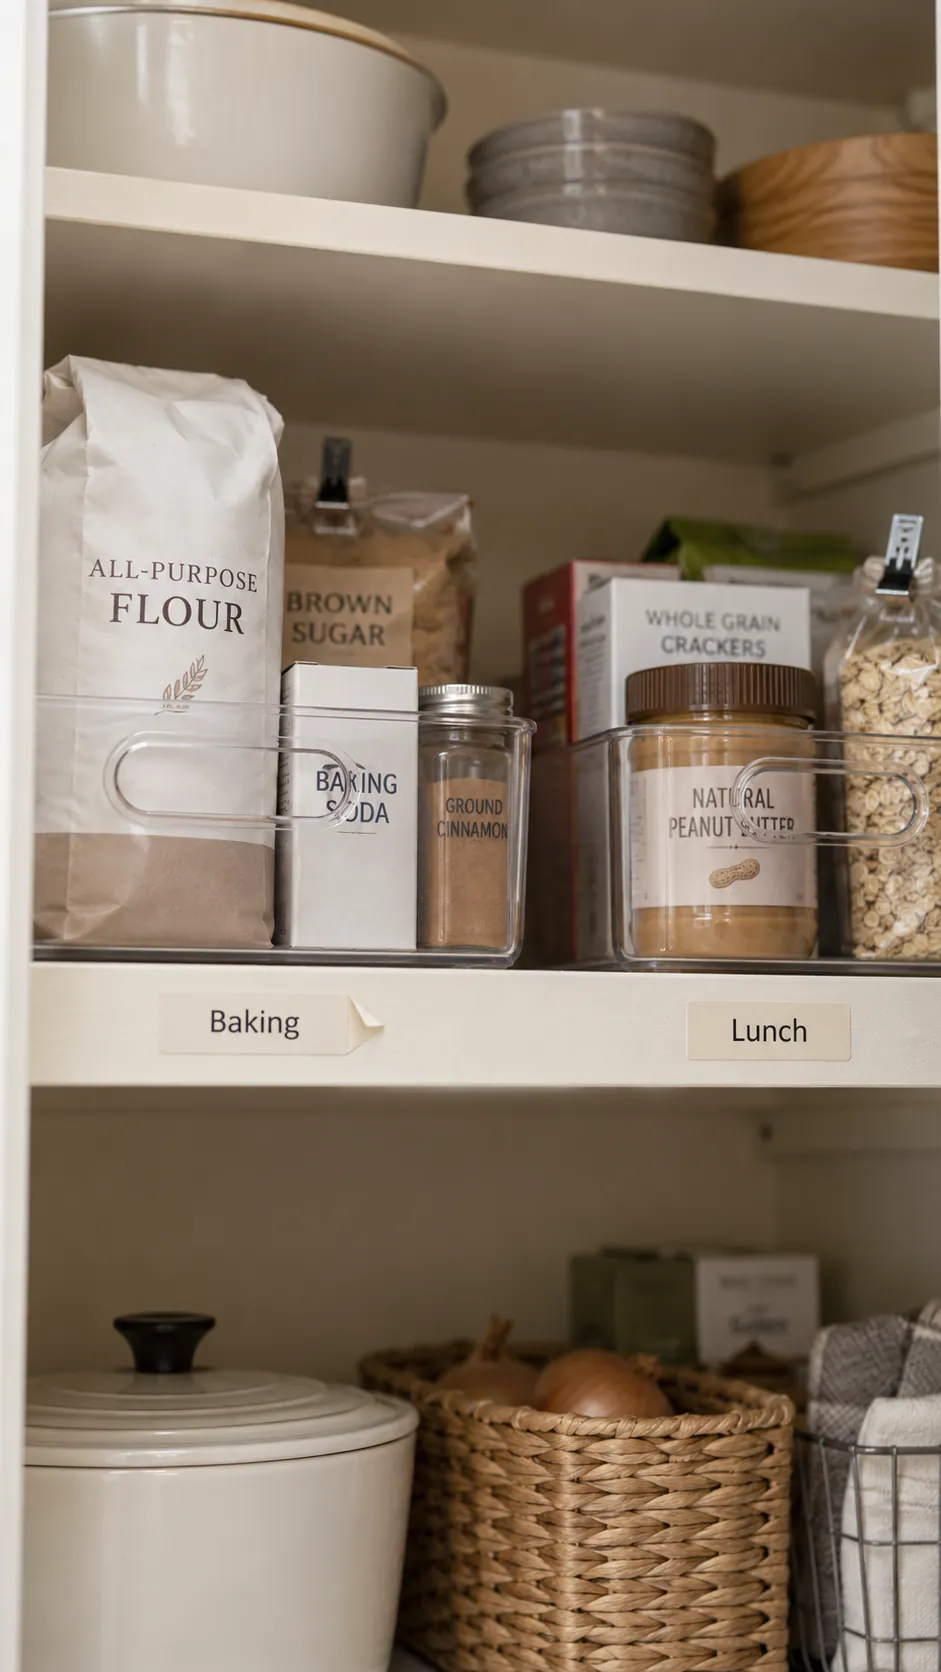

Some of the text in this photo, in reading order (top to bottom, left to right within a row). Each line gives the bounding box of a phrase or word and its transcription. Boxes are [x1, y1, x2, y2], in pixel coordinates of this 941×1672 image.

[89, 558, 258, 592] ALL-PURPOSE
[109, 592, 245, 635] FLOUR
[286, 590, 393, 615] BROWN
[645, 608, 782, 632] WHOLE GRAIN
[291, 621, 386, 647] SUGAR
[660, 634, 768, 659] CRACKERS
[316, 770, 398, 795] BAKING
[445, 797, 503, 815] GROUND
[692, 787, 775, 809] NATURAL
[437, 820, 509, 840] CINNAMON
[668, 815, 796, 839] PEANUT TTER
[210, 1008, 300, 1040] Baking
[732, 1017, 807, 1043] Lunch
